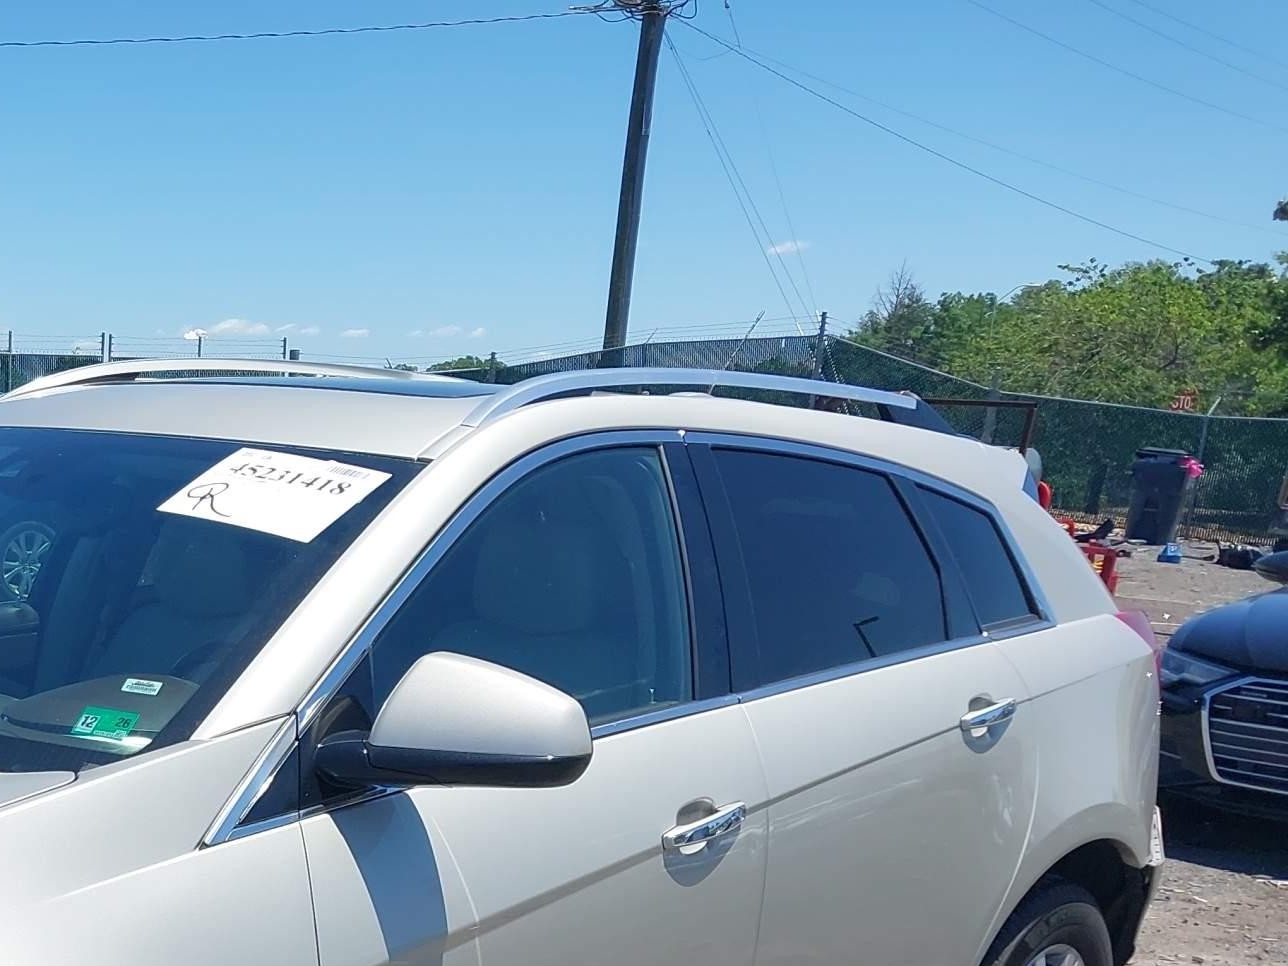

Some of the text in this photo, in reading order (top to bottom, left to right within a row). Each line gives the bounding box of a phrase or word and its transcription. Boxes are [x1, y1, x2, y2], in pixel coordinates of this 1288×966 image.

[1169, 394, 1196, 409] STO
[229, 462, 352, 496] 45231418
[81, 715, 133, 729] 12 26
